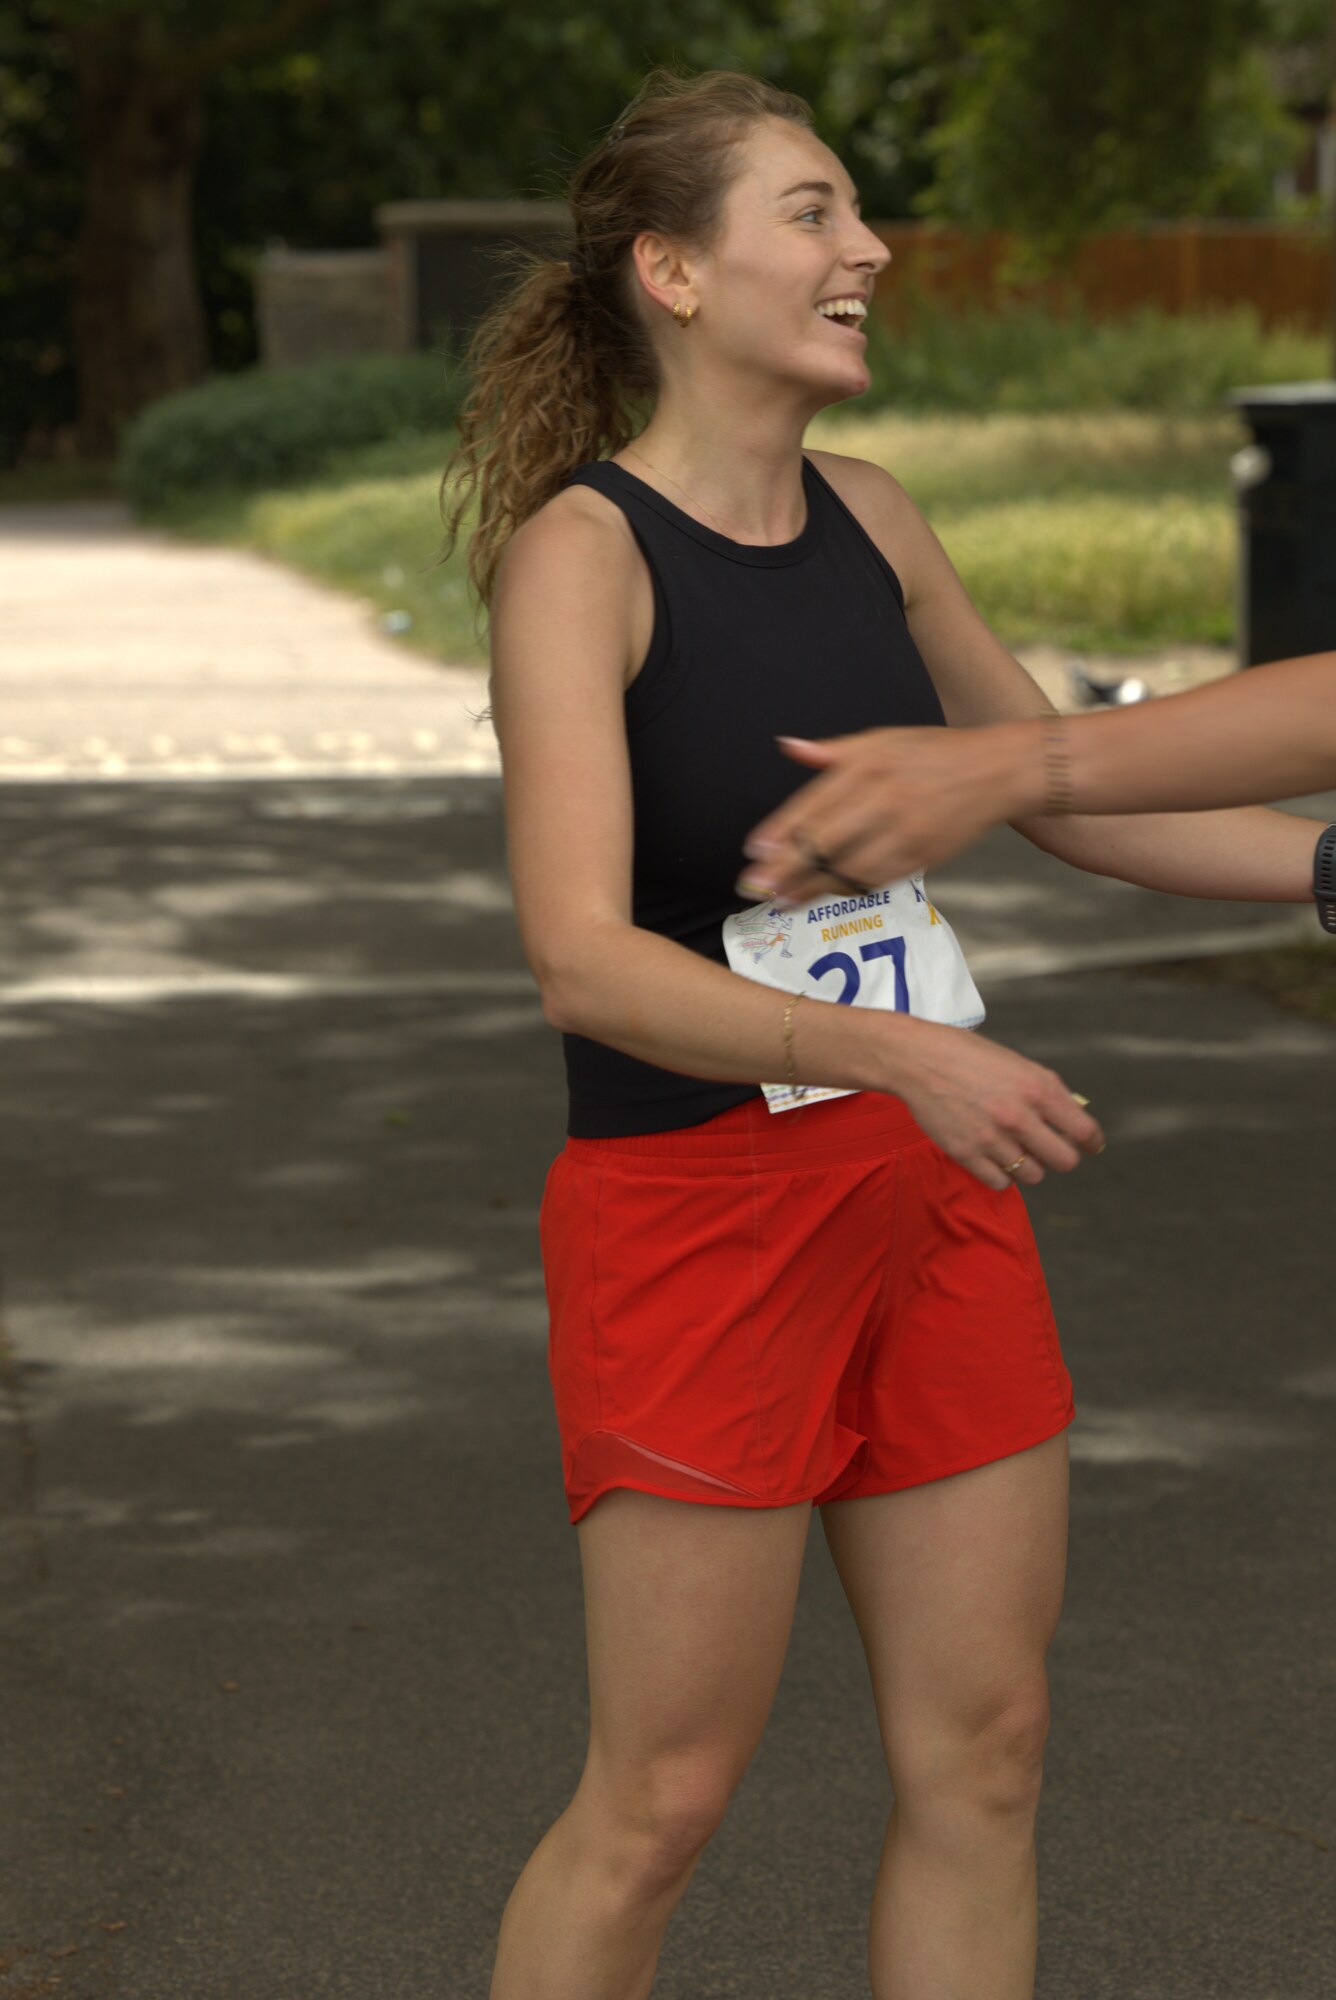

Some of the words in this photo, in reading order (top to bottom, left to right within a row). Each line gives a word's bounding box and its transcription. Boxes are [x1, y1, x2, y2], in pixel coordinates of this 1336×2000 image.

[807, 890, 891, 924] AFFORDABLE
[821, 914, 884, 942] RUNNING
[807, 936, 909, 1014] 27
